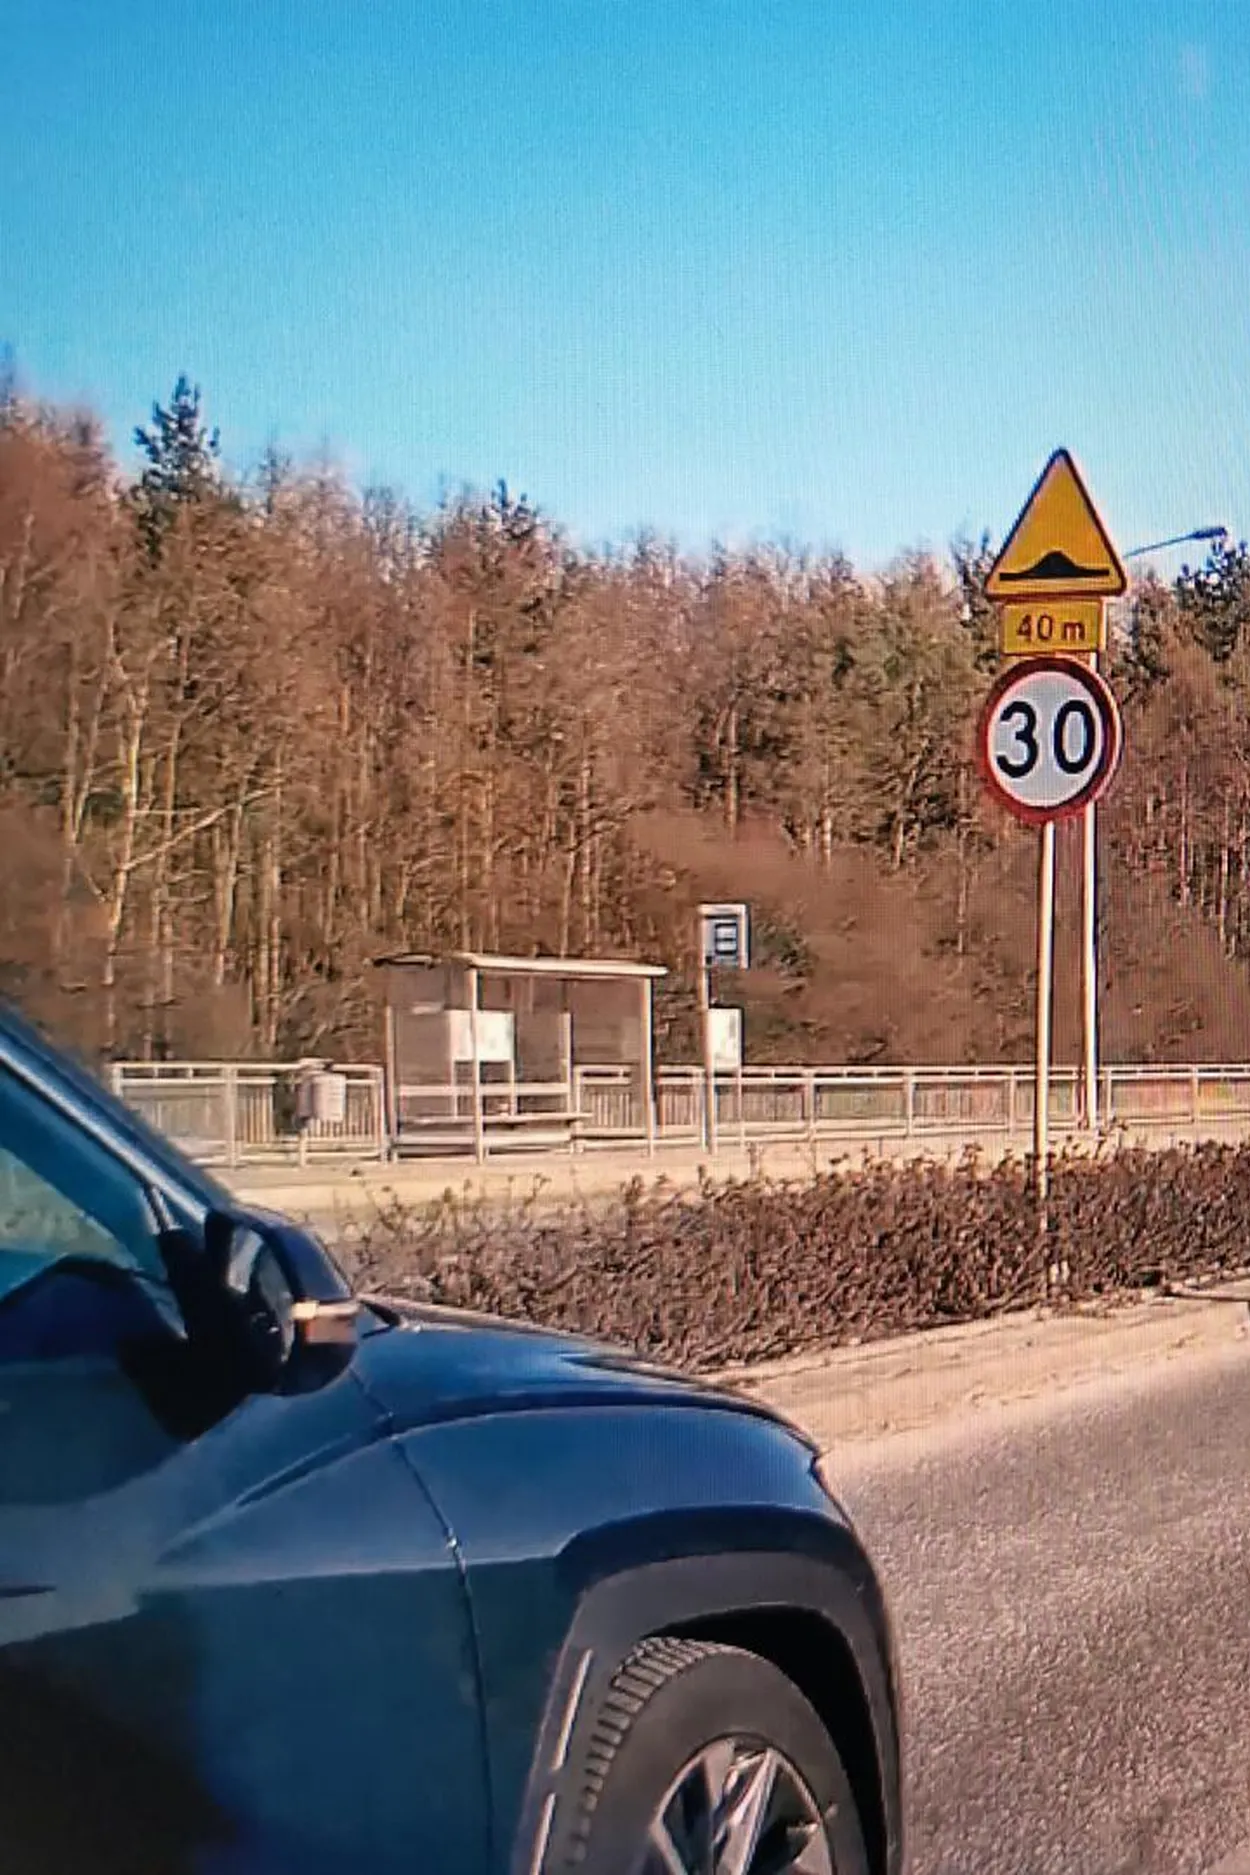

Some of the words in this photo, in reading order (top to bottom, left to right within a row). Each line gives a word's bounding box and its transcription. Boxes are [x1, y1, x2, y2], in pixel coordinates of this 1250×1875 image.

[1017, 614, 1053, 643] 40
[1062, 620, 1085, 641] m
[996, 700, 1096, 778] 30
